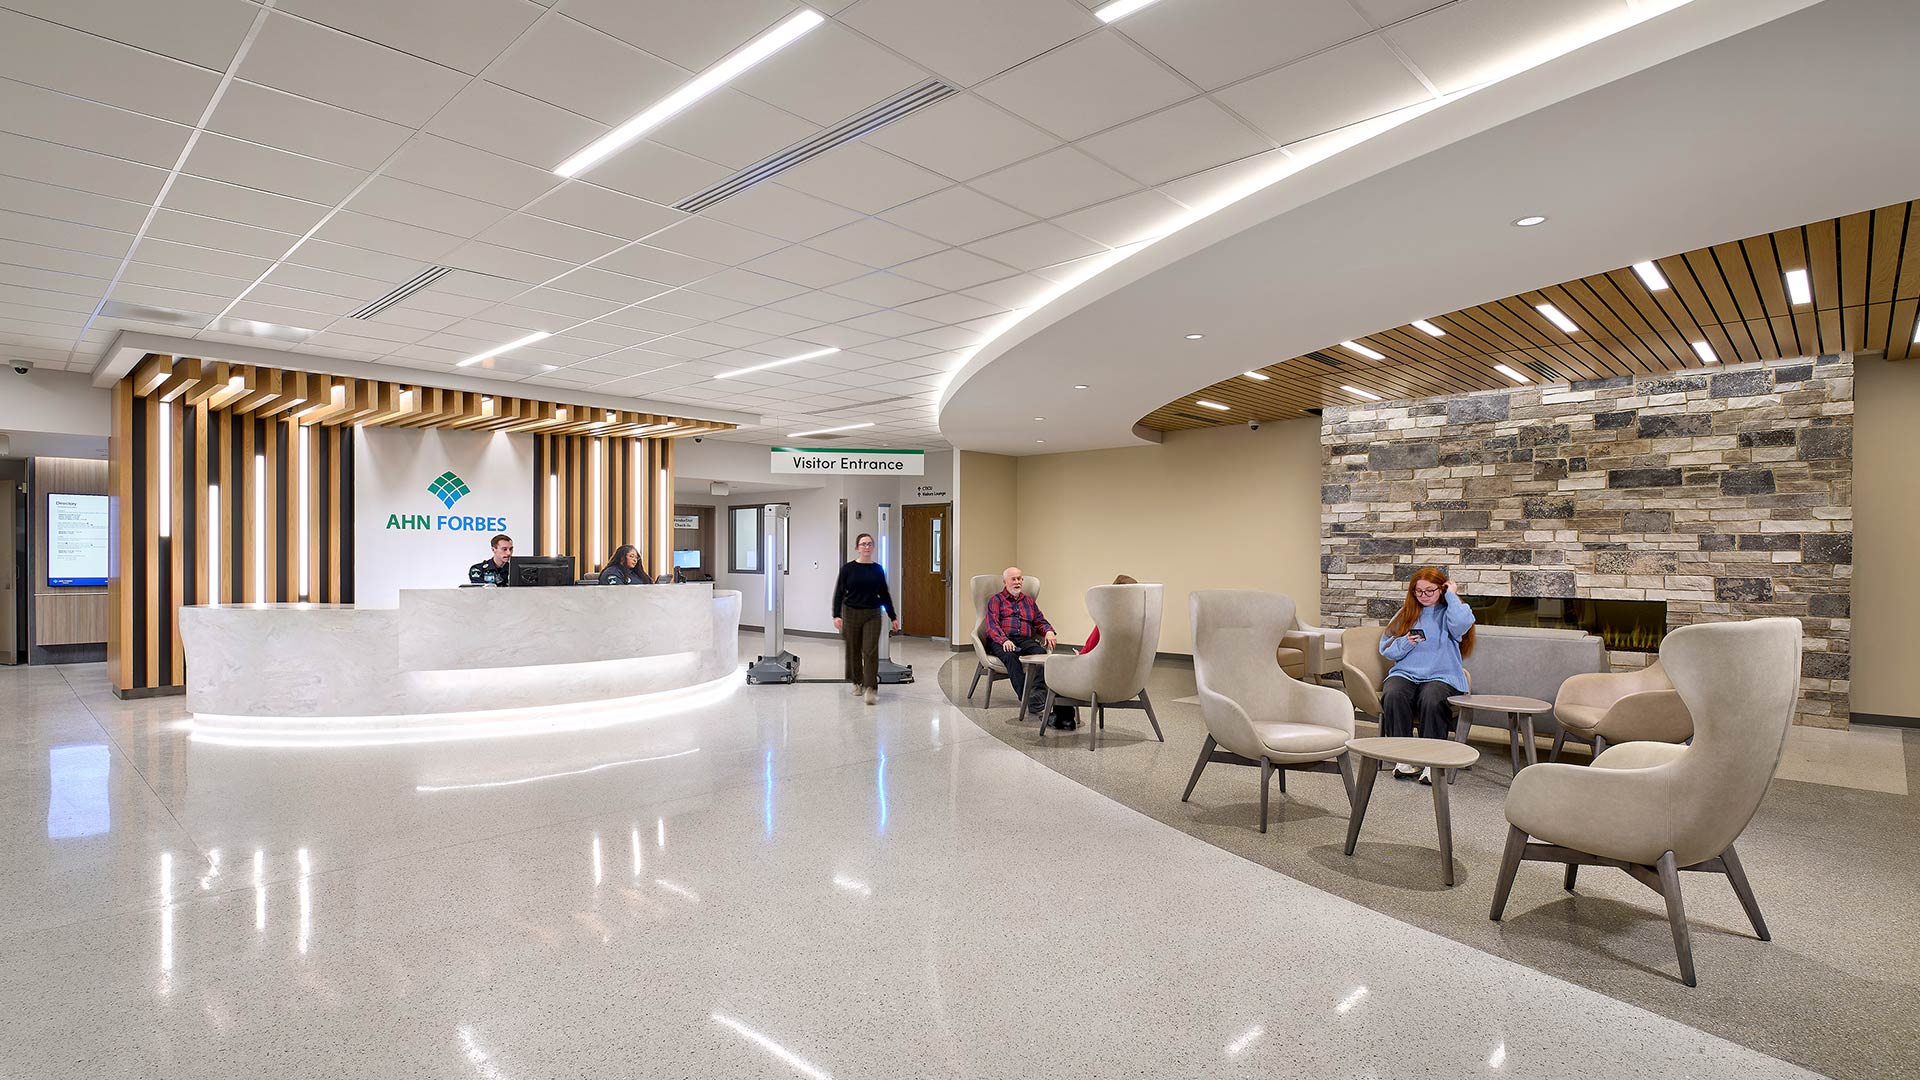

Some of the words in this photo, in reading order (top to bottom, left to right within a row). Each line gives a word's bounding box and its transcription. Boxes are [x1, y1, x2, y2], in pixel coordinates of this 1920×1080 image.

[793, 457, 836, 469] Visitor
[841, 457, 904, 470] Entrance
[386, 514, 430, 530] AHN
[437, 515, 507, 532] FORBES
